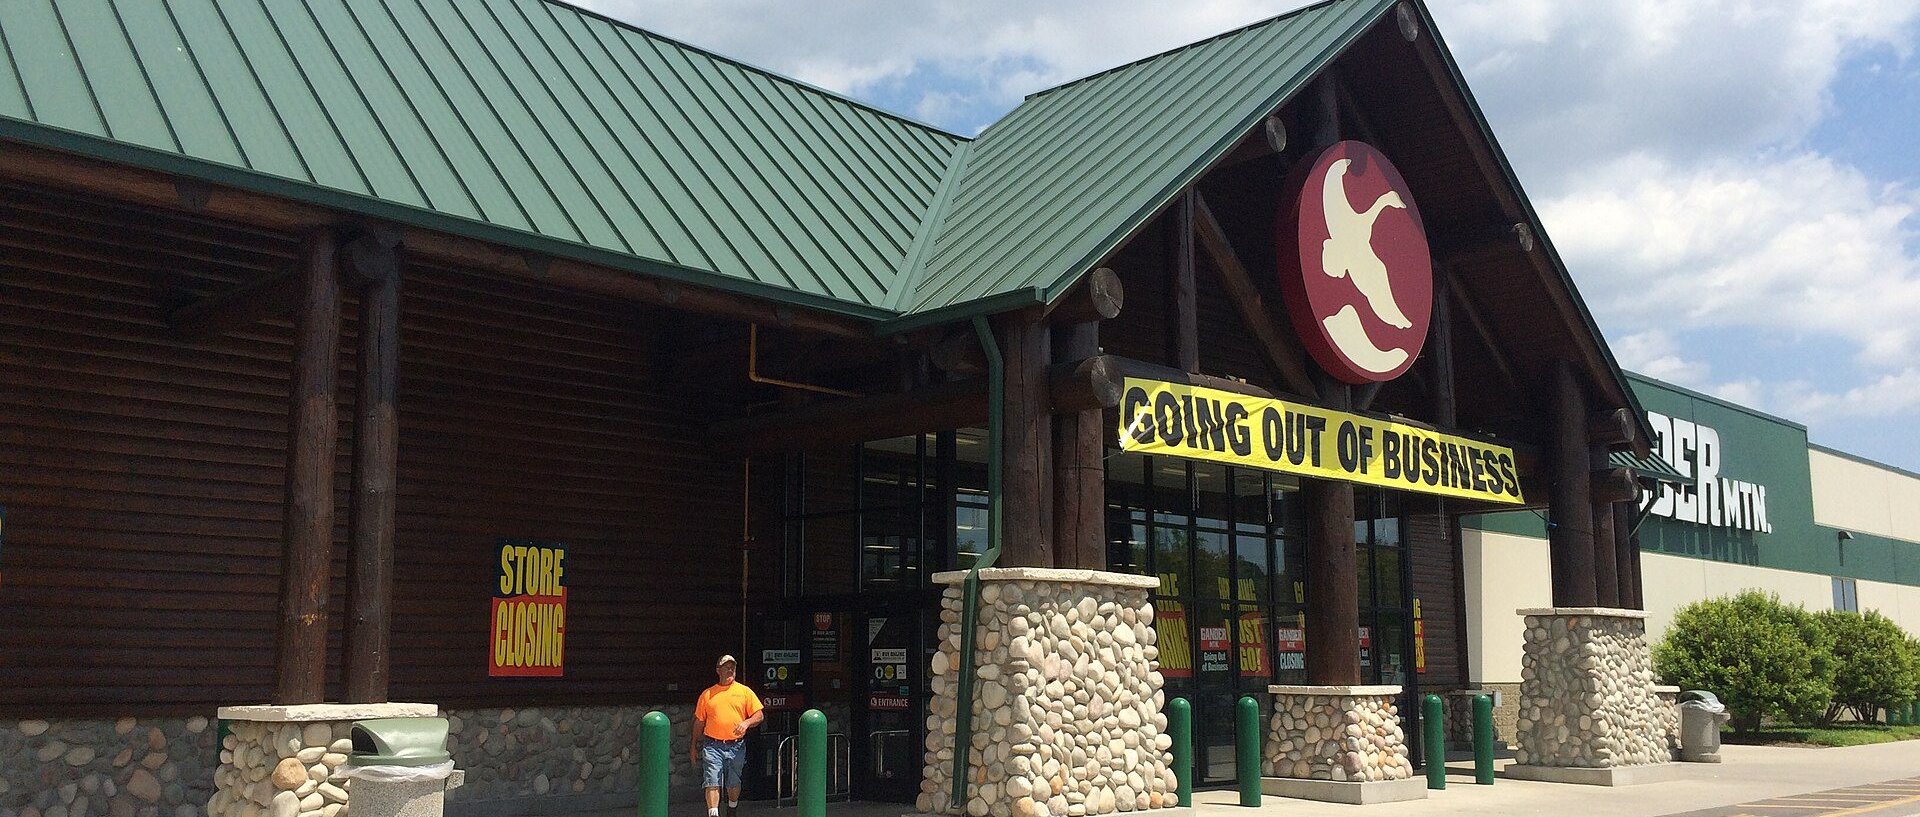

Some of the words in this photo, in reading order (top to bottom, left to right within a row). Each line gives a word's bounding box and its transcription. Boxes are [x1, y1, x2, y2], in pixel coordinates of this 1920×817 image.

[1124, 386, 1251, 456] GOING
[1262, 407, 1326, 467] OUT
[1337, 420, 1373, 475] OF
[1382, 430, 1520, 497] BUSINESS
[1640, 411, 1721, 527] DER
[1723, 477, 1772, 534] MTN.
[500, 544, 565, 596] STORE
[815, 613, 831, 623] STOP
[495, 601, 564, 668] CLOSING
[1200, 627, 1226, 641] GANDER
[1278, 629, 1302, 641] GANDER
[1203, 651, 1217, 662] Going
[1218, 651, 1226, 661] Out
[1239, 646, 1262, 673] GO!
[1280, 653, 1305, 669] CLOSING
[1202, 662, 1208, 672] of
[1208, 662, 1229, 672] Business
[772, 697, 786, 706] EXIT
[878, 698, 909, 707] ENTRANCE
